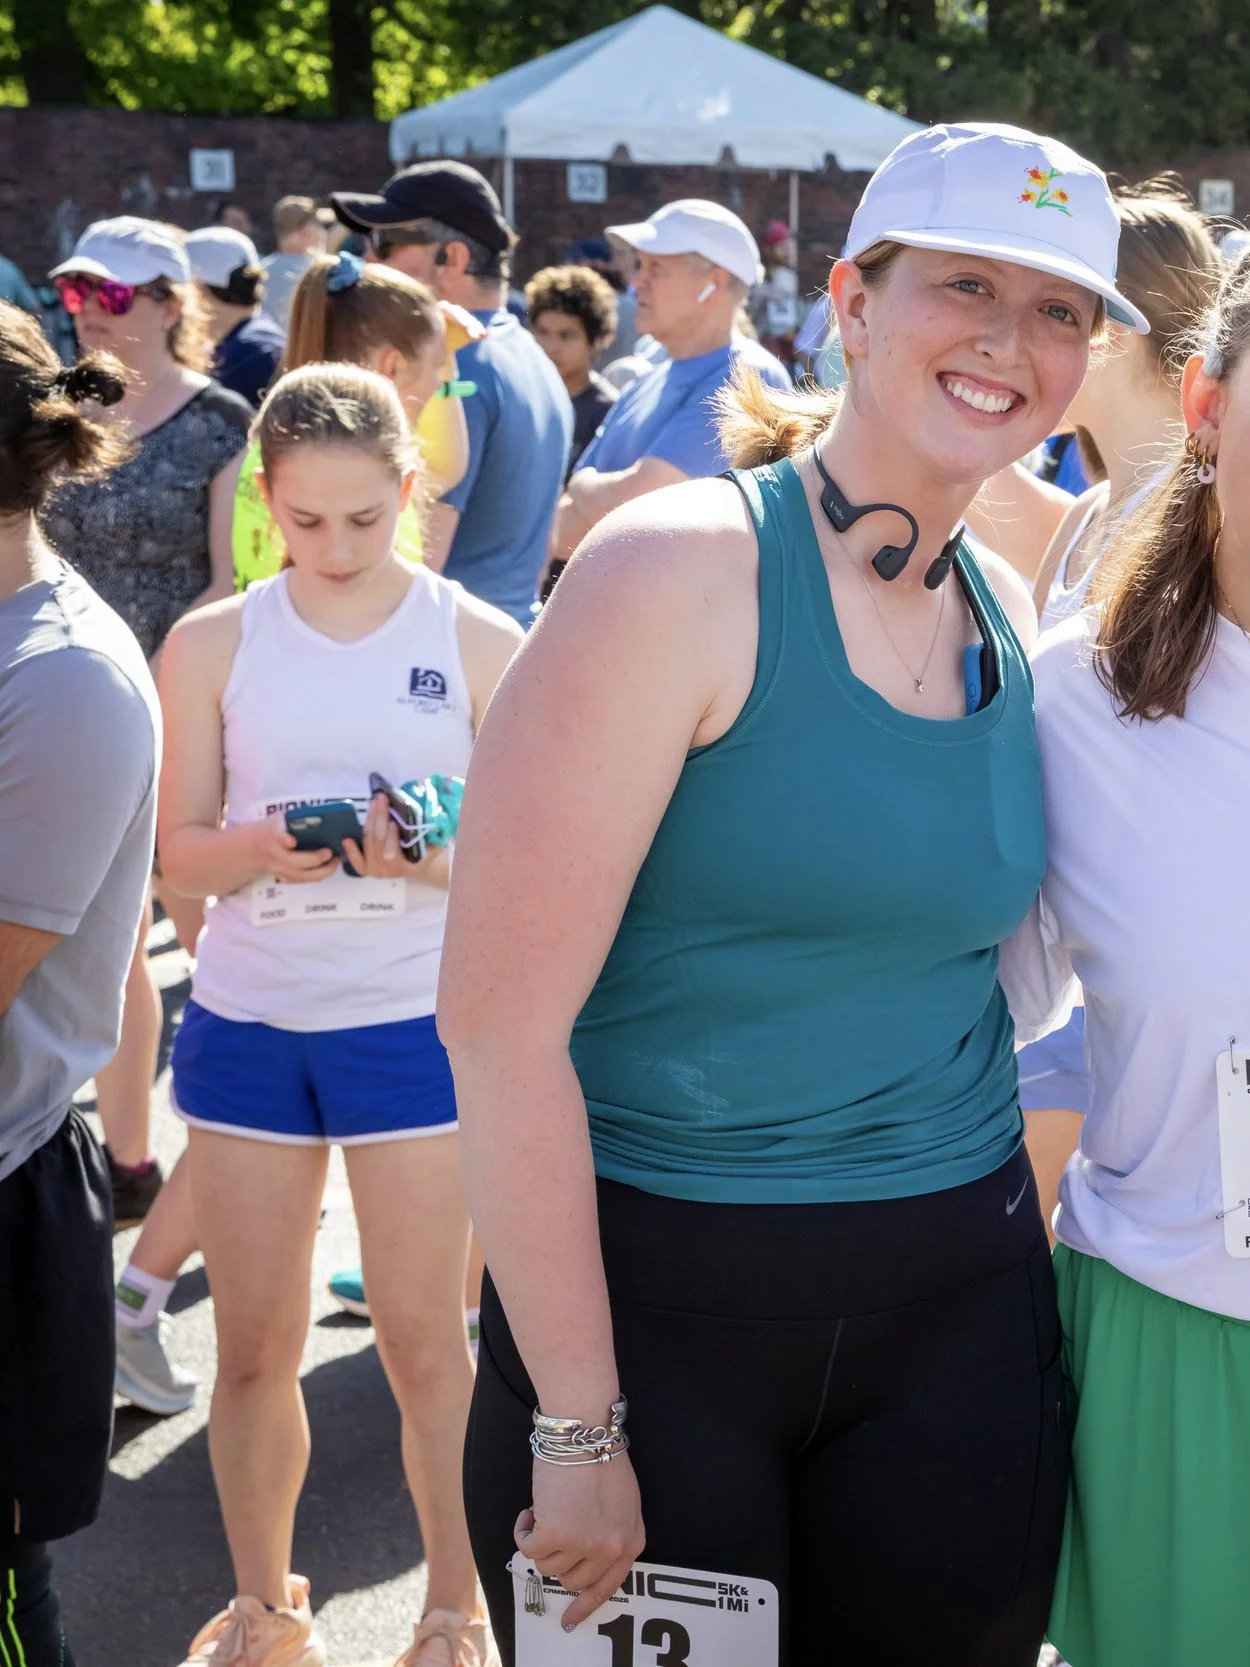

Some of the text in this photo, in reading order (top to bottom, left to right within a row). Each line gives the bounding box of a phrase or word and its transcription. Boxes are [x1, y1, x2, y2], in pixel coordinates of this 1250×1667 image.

[305, 904, 338, 914] DRINK
[360, 903, 395, 913] DRINK
[543, 1588, 579, 1597] CAMBRID
[717, 1582, 749, 1597] 5K&
[598, 1613, 690, 1667] 13
